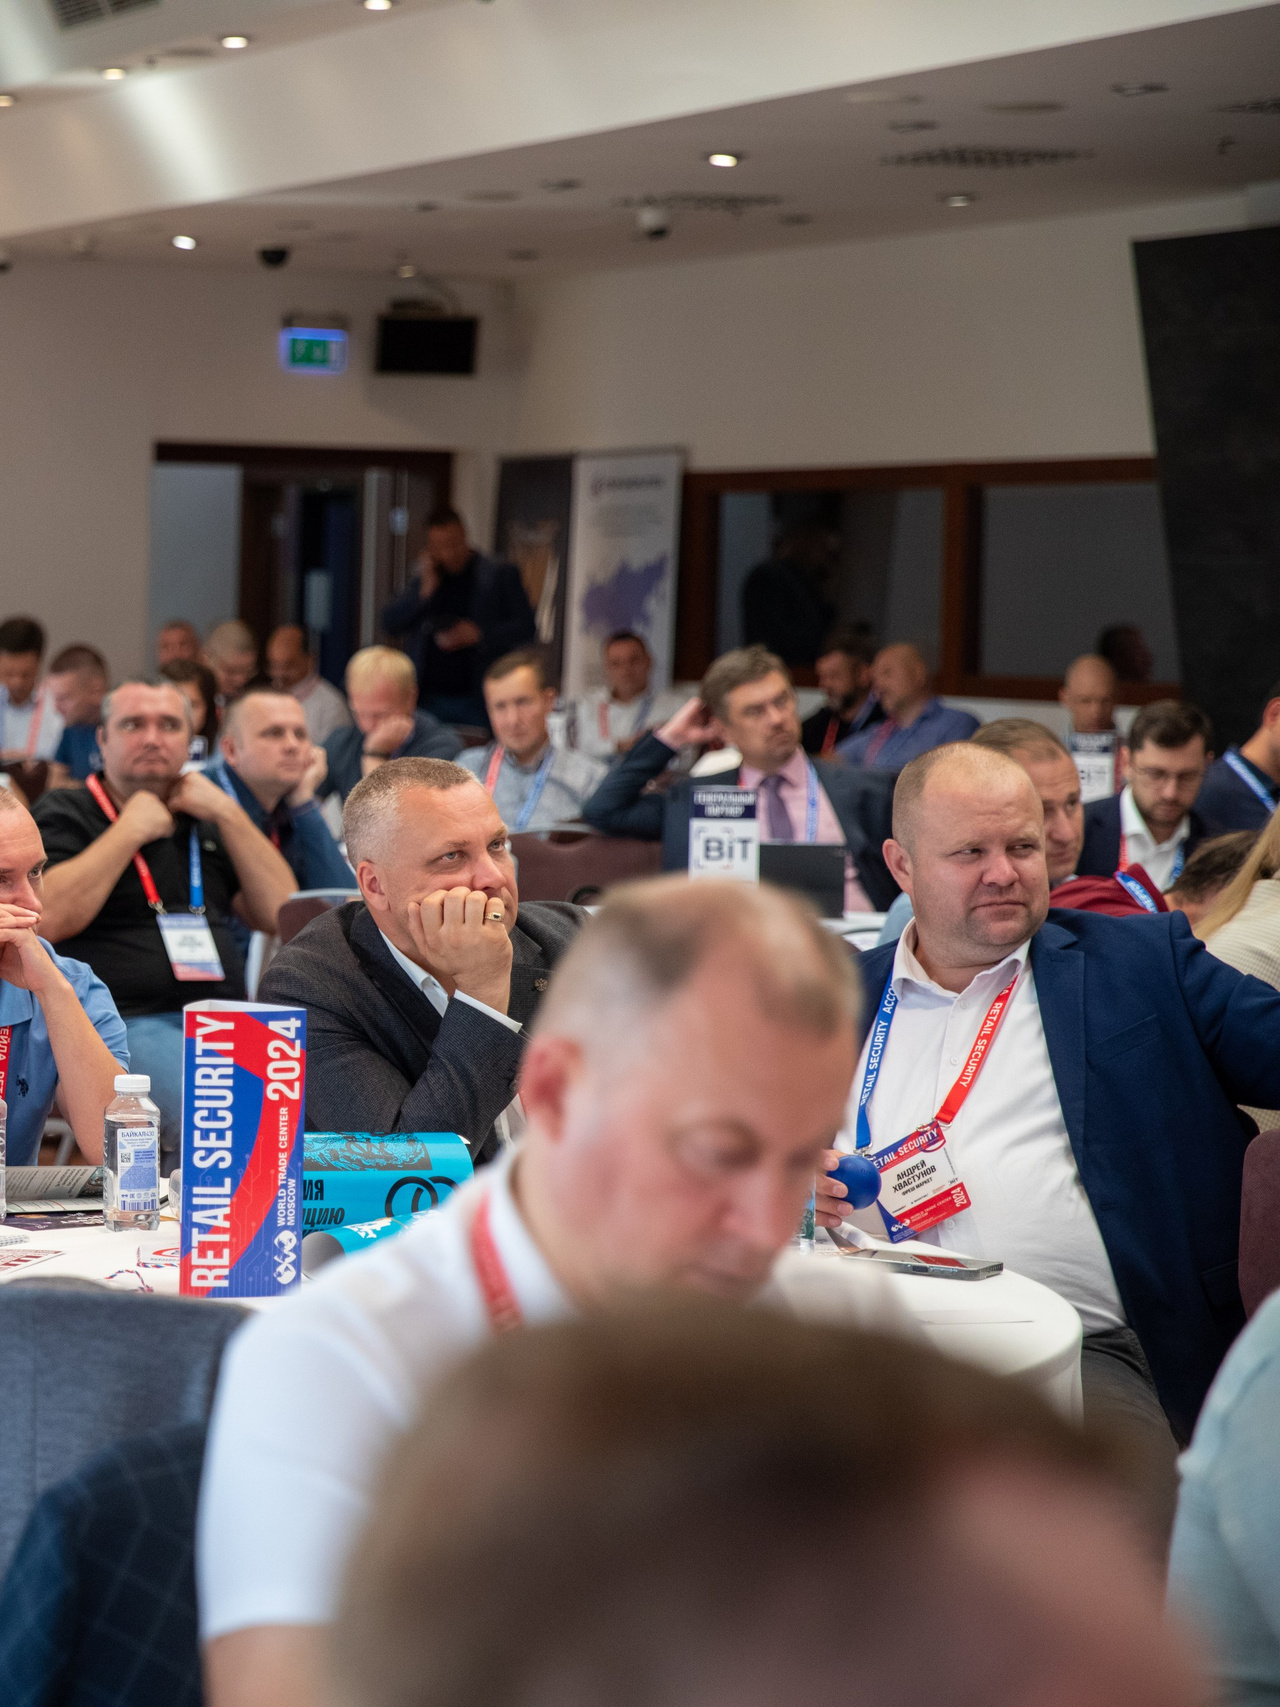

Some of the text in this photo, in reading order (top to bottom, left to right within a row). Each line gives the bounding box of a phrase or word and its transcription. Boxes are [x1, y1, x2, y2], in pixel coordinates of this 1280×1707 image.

[266, 1017, 301, 1101] 2024
[869, 1020, 888, 1069] SECURITY
[959, 1002, 1003, 1088] RETAIL SECURITY
[190, 1015, 235, 1288] RETAIL SECURITY
[277, 1107, 289, 1227] WORLD TRADE CENTER
[873, 1128, 939, 1169] ETAIL SECURITY
[896, 1159, 927, 1181] АНДРЕЙ
[287, 1178, 296, 1226] MOSCOW
[892, 1164, 937, 1193] ХВАСТУНОВ
[951, 1186, 967, 1207] 2024
[302, 1207, 345, 1227] ЦИЮ
